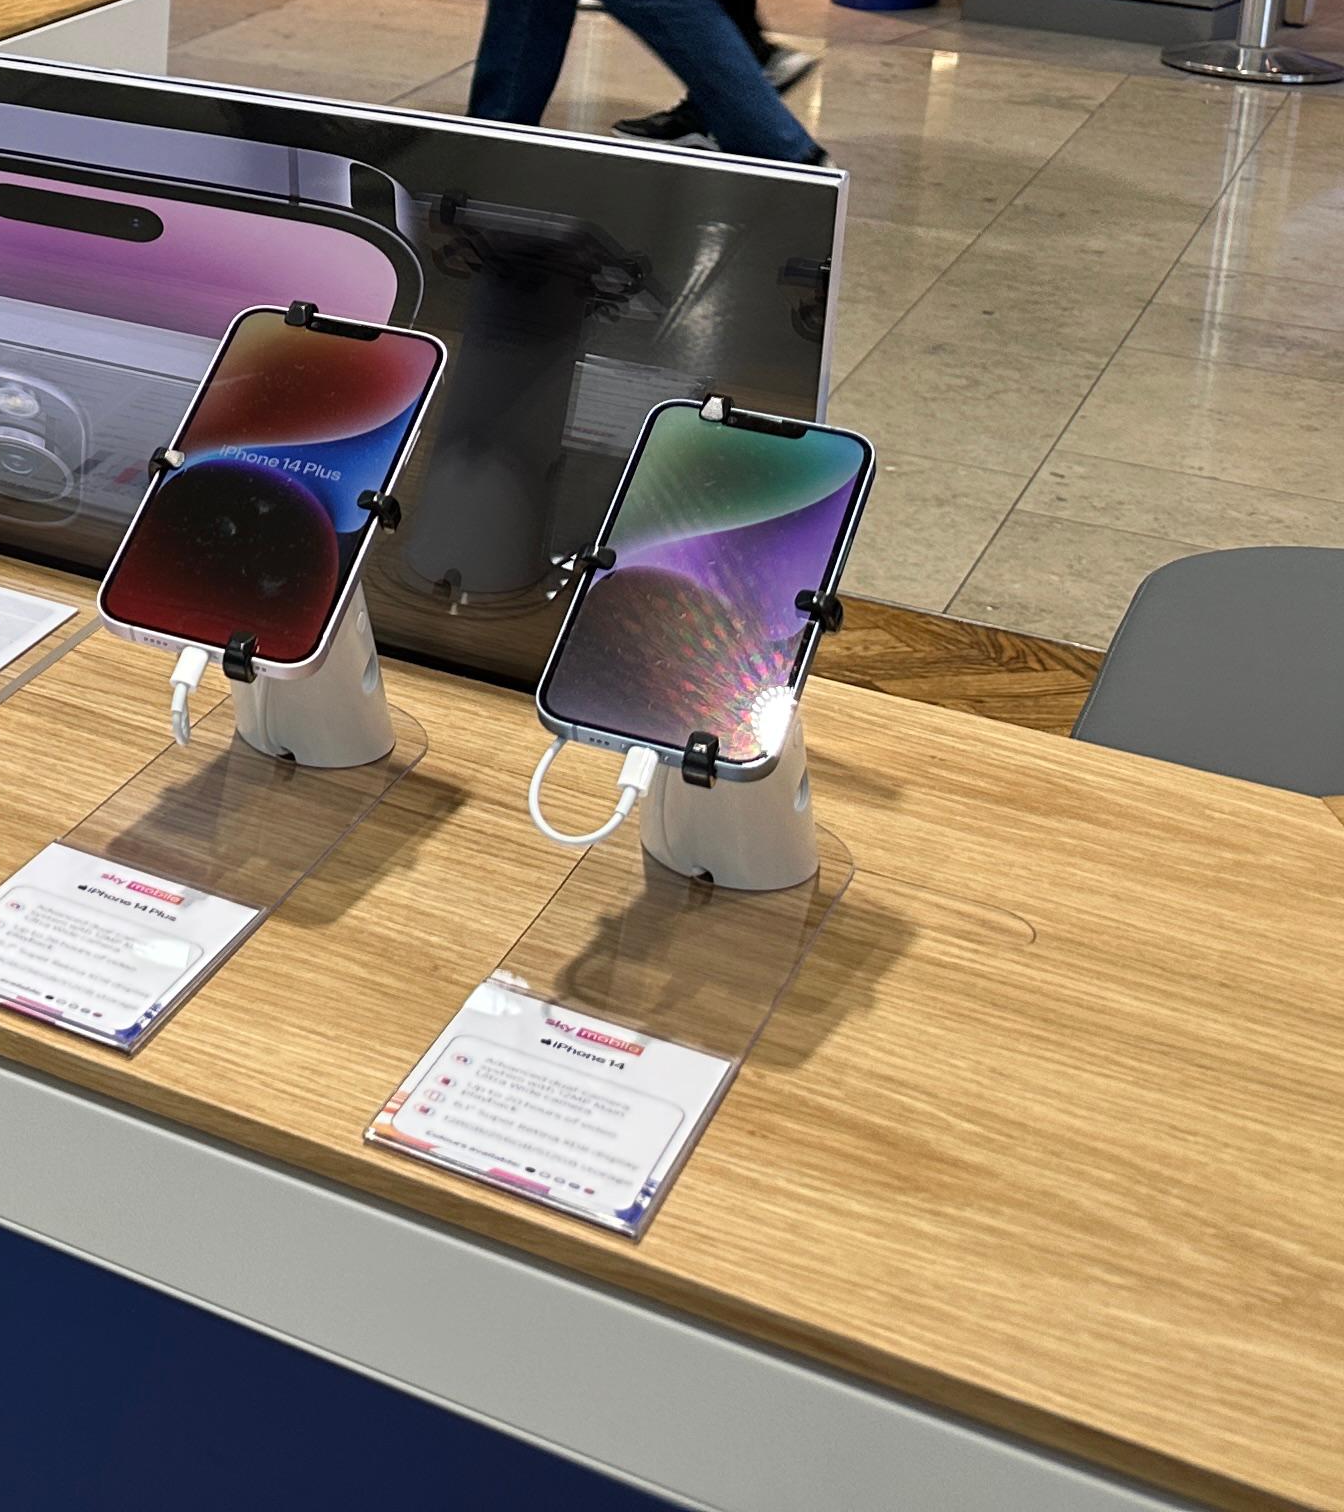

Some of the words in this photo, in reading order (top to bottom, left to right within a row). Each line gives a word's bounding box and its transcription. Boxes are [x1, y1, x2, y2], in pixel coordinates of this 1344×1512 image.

[219, 444, 280, 468] iPhone
[282, 457, 302, 472] 14
[303, 462, 342, 481] Plus
[86, 886, 133, 905] iPhone
[148, 908, 178, 921] Plus
[99, 872, 127, 885] sky
[129, 882, 181, 903] mobile
[543, 1017, 576, 1033] sky
[579, 1029, 641, 1054] mobile
[552, 1041, 607, 1064] iPhone
[607, 1059, 625, 1069] 14
